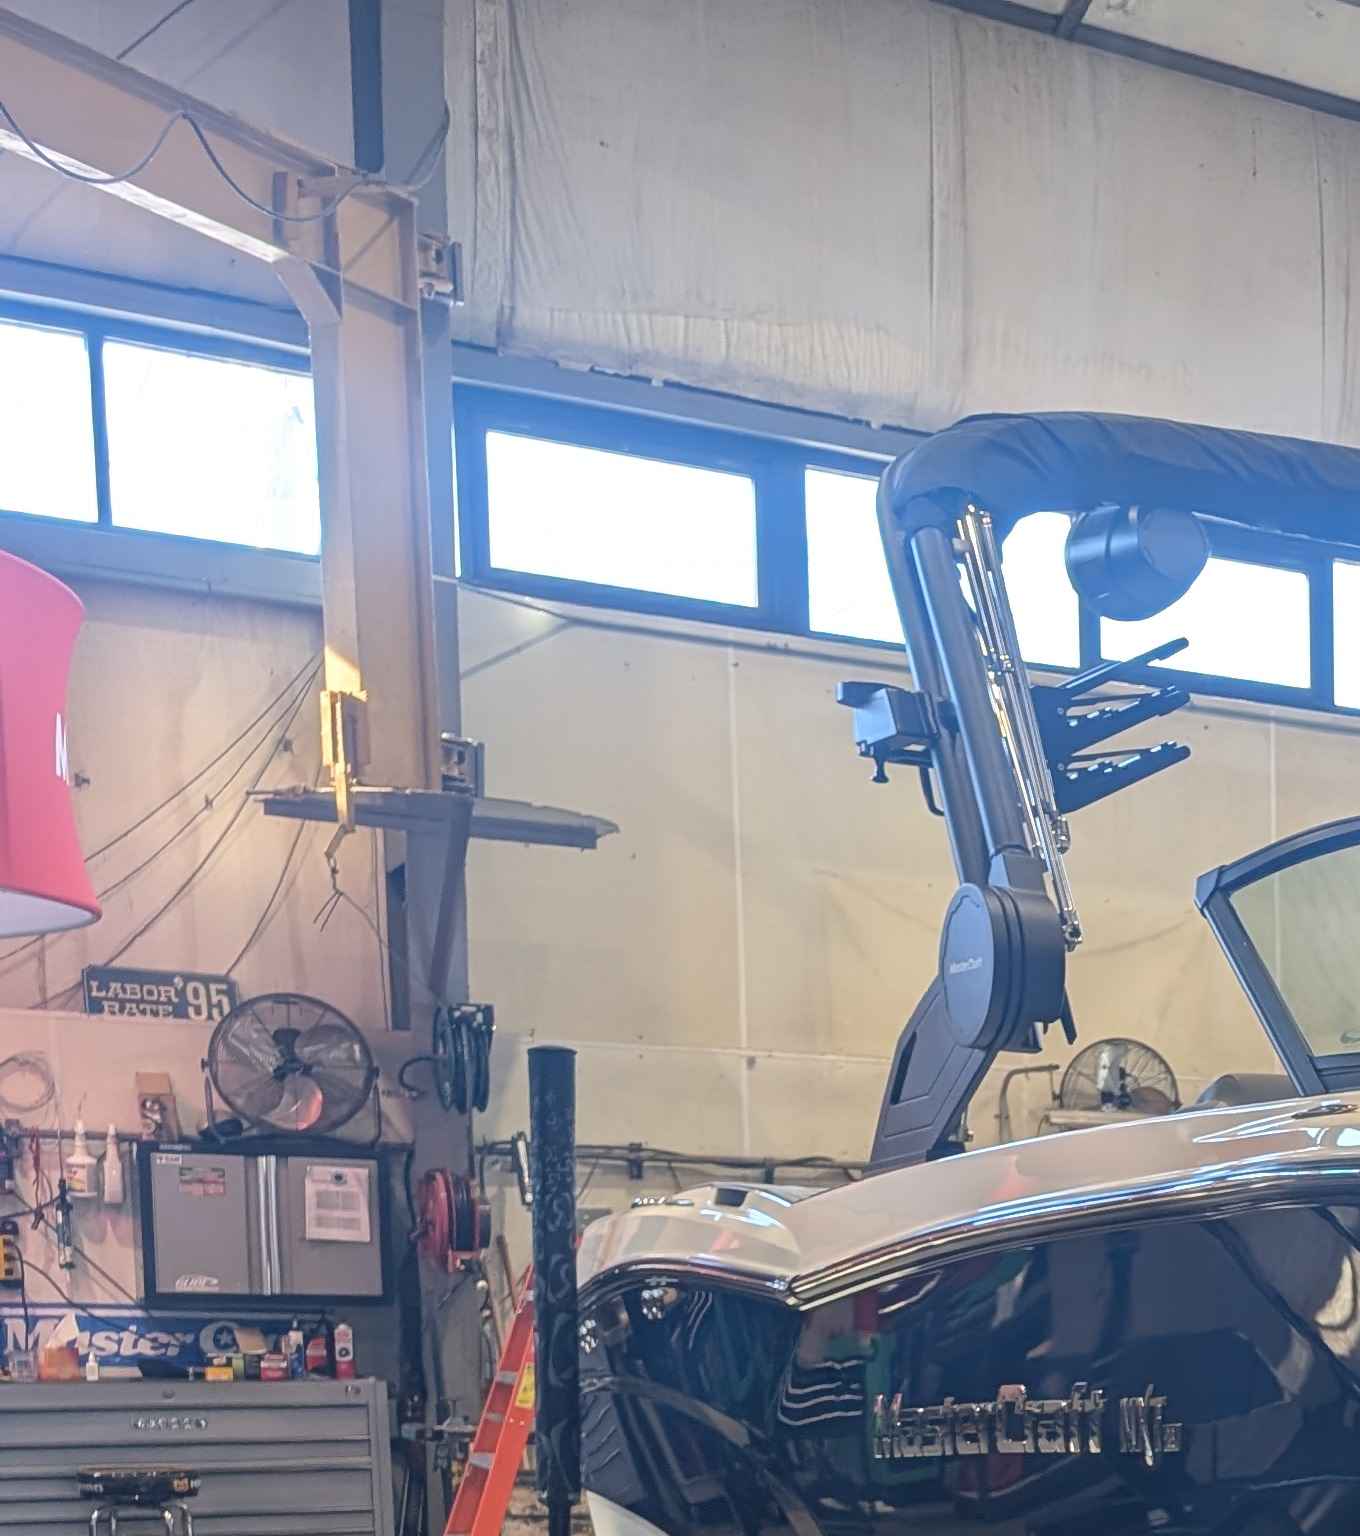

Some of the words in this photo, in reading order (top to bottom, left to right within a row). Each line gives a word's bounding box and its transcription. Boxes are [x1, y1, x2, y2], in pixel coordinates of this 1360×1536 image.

[89, 980, 180, 1003] LABOR
[101, 1001, 174, 1019] RATE
[873, 1380, 1104, 1460] MasterCraft
